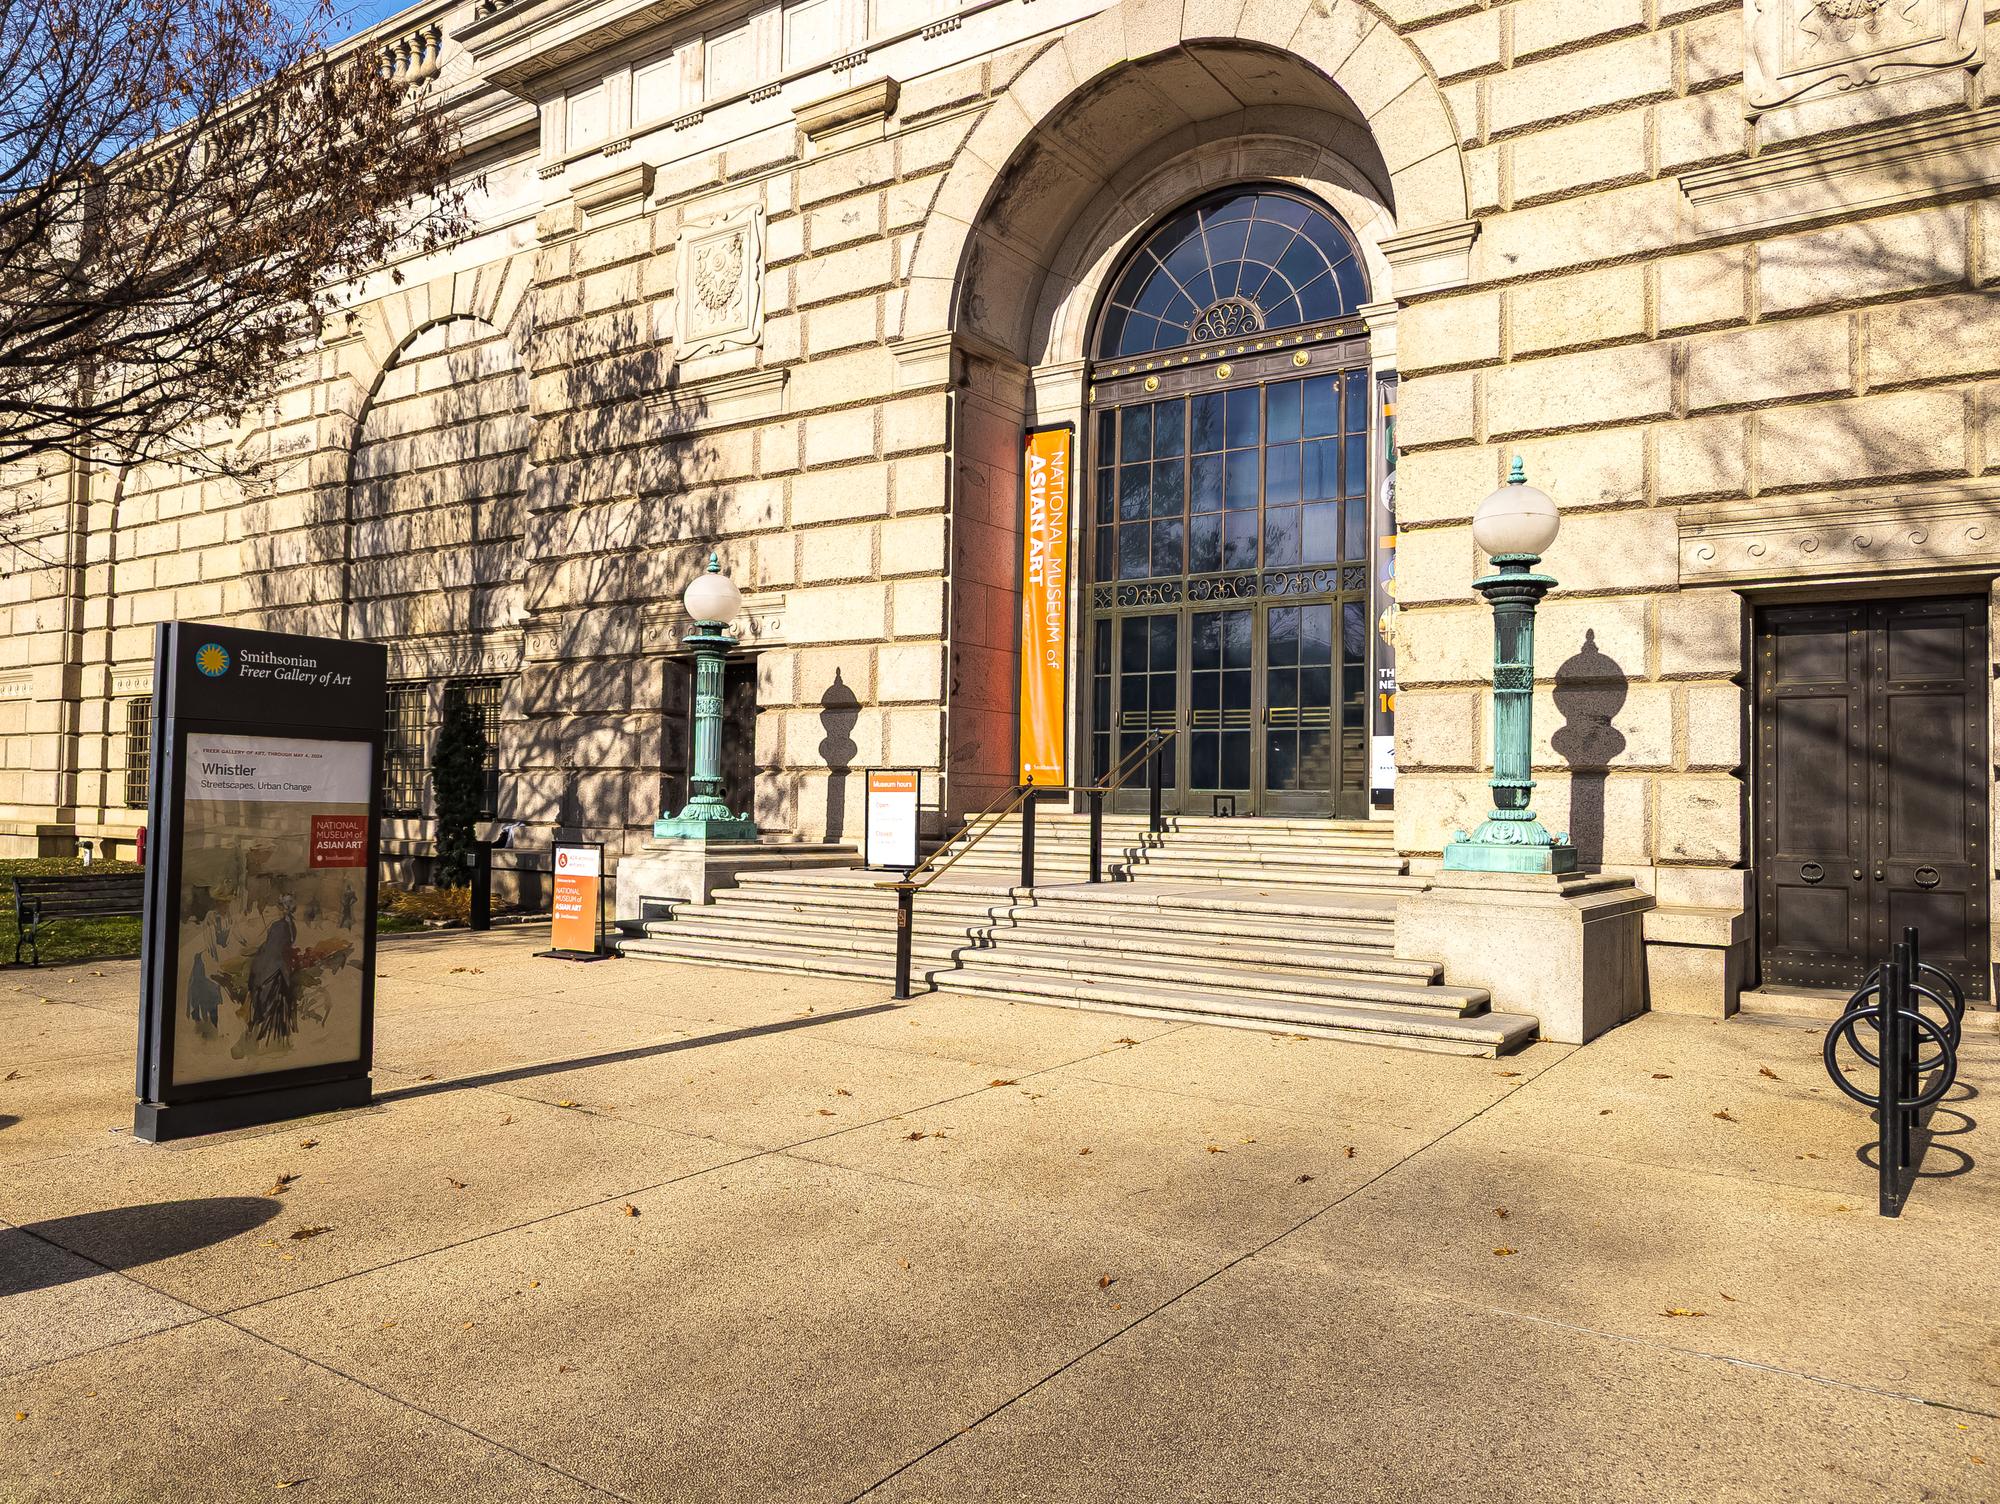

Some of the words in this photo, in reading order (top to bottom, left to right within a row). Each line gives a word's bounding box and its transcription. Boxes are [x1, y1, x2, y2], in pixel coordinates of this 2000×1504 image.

[1029, 455, 1046, 532] ASIAN
[1049, 451, 1064, 552] NATIONAL
[1029, 537, 1044, 587] ART
[1046, 558, 1062, 643] MUSEUM
[240, 649, 317, 668] Smithsonian
[1046, 649, 1059, 669] of
[240, 664, 272, 678] Freer
[274, 667, 317, 685] Gallery
[319, 671, 333, 687] of
[332, 673, 352, 686] Art
[202, 762, 257, 777] Whistler
[258, 781, 281, 791] Urban
[283, 782, 312, 793] Change
[317, 821, 359, 830] NATIONAL
[317, 831, 353, 839] MUSEUM
[354, 830, 363, 839] of
[316, 840, 344, 849] ASIAN
[345, 840, 363, 849] ART
[556, 887, 580, 895] NATIONAL
[555, 895, 577, 903] MUSEUM
[555, 903, 570, 911] ASIAN
[570, 904, 582, 912] ART
